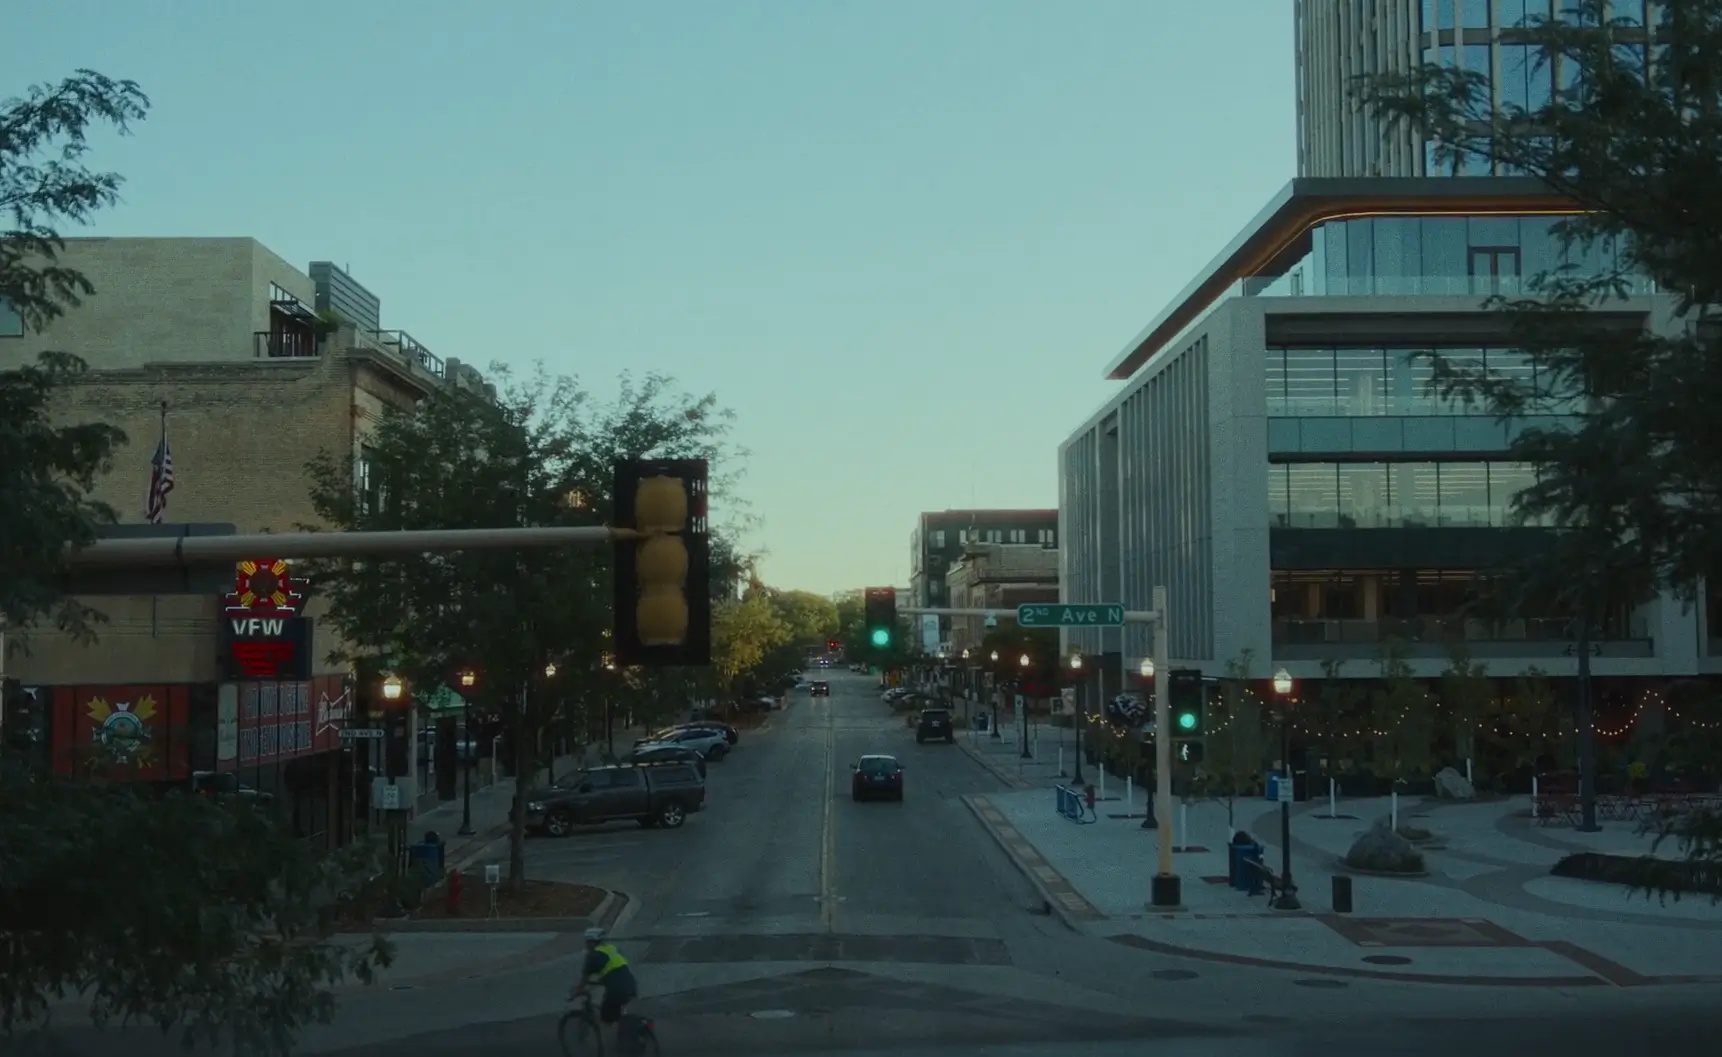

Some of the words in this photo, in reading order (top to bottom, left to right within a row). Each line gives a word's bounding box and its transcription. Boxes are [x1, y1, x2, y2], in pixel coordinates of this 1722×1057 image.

[1023, 608, 1049, 622] 2ND
[1062, 608, 1097, 622] Ave
[1108, 608, 1120, 622] N
[232, 618, 284, 636] VFW
